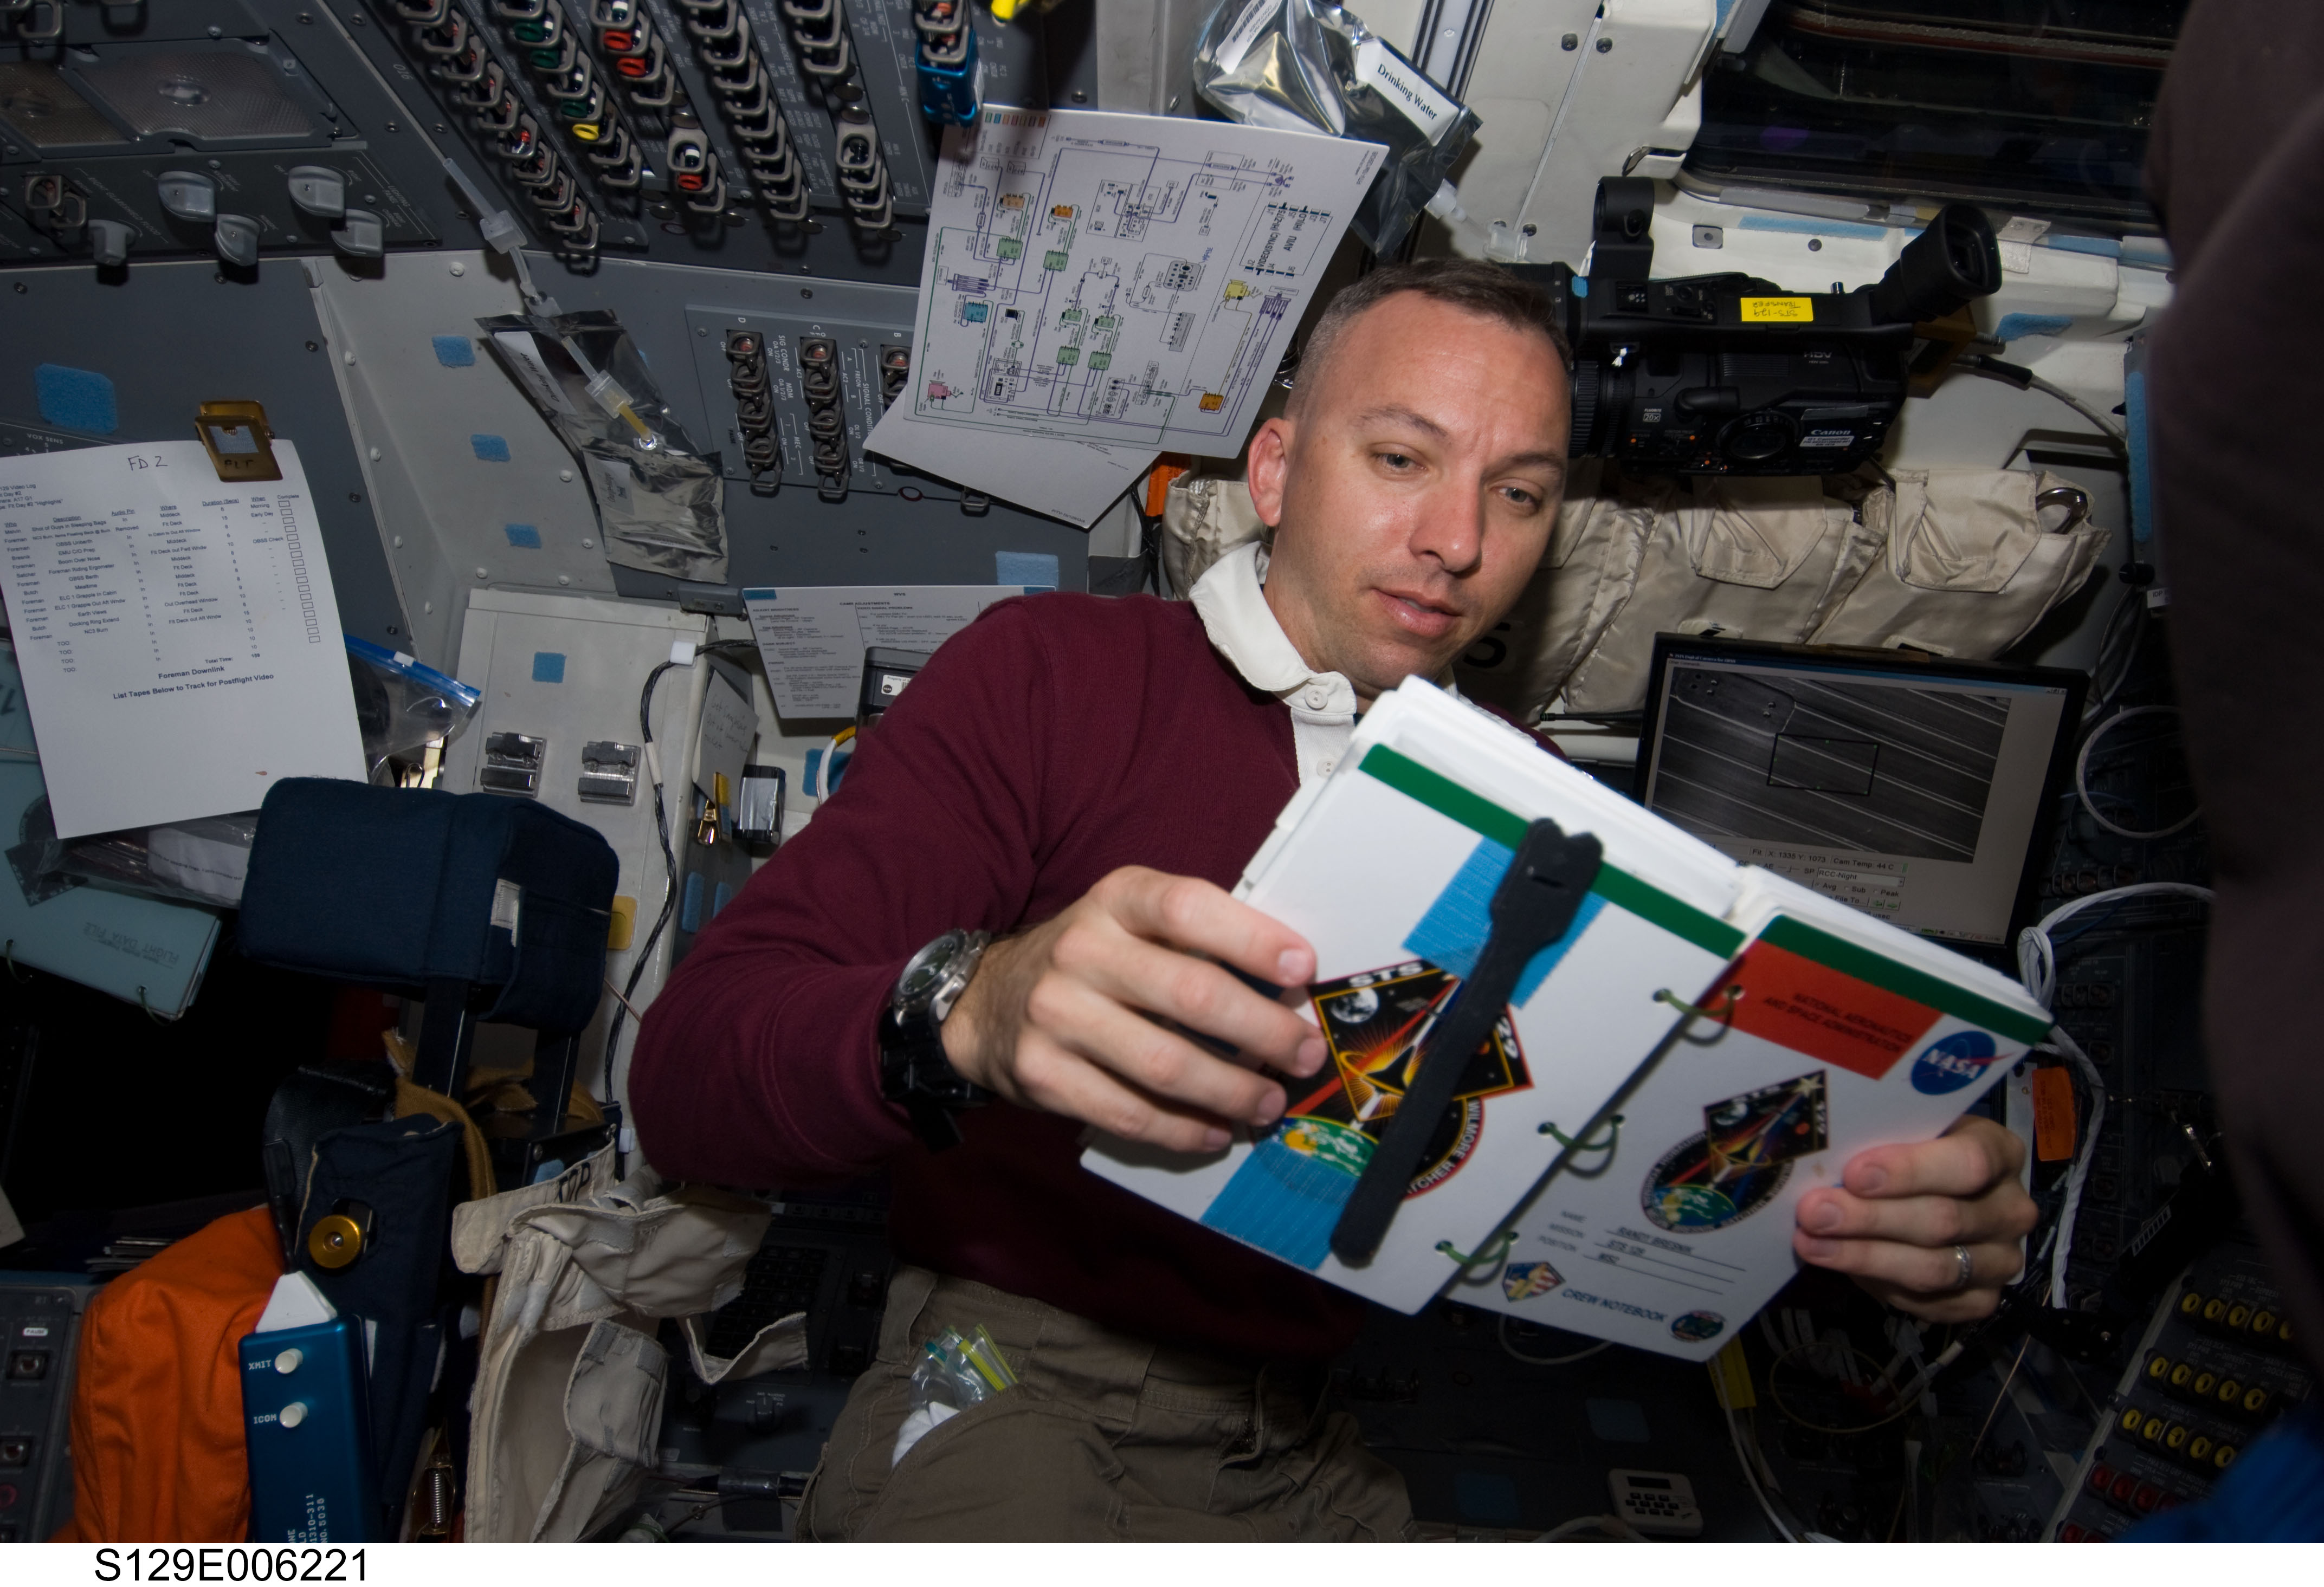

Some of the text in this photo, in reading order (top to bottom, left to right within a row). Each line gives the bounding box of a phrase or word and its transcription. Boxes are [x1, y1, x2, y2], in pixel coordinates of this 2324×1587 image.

[1377, 63, 1438, 121] Drinking Water
[1283, 235, 1297, 251] AVIU
[1753, 300, 1797, 308] TRANSFER
[1753, 309, 1798, 318] STS-129
[767, 348, 773, 357] ON
[780, 348, 790, 371] CONDR
[773, 385, 779, 393] ON
[849, 427, 854, 435] ON
[45, 437, 64, 445] SENS
[782, 437, 787, 446] ON
[127, 456, 149, 471] FD
[158, 665, 225, 679] Foreman Downlink
[130, 690, 150, 698] Tapes
[219, 676, 253, 686] Postflight
[1779, 852, 1796, 860] 1335
[1834, 858, 1850, 866] Cam
[1819, 870, 1857, 881] RCC-Night
[1823, 883, 1837, 891] Avg
[1881, 889, 1899, 897] Peak
[1349, 962, 1424, 988] STS
[1764, 996, 1788, 1010] AND
[1787, 1005, 1822, 1024] SPACE
[1793, 993, 1840, 1017] NATIONAL
[1922, 1049, 1979, 1079] NASA
[1454, 1100, 1481, 1159] WILMORE
[1561, 1210, 1587, 1223] NAME
[1548, 1223, 1585, 1238] MISSION
[1617, 1227, 1651, 1242] RANDY
[1539, 1235, 1578, 1252] POSITION
[1562, 1287, 1668, 1323] CREW NOTEBOOK
[248, 1359, 272, 1370] XMIT
[253, 1414, 277, 1424] ICOM
